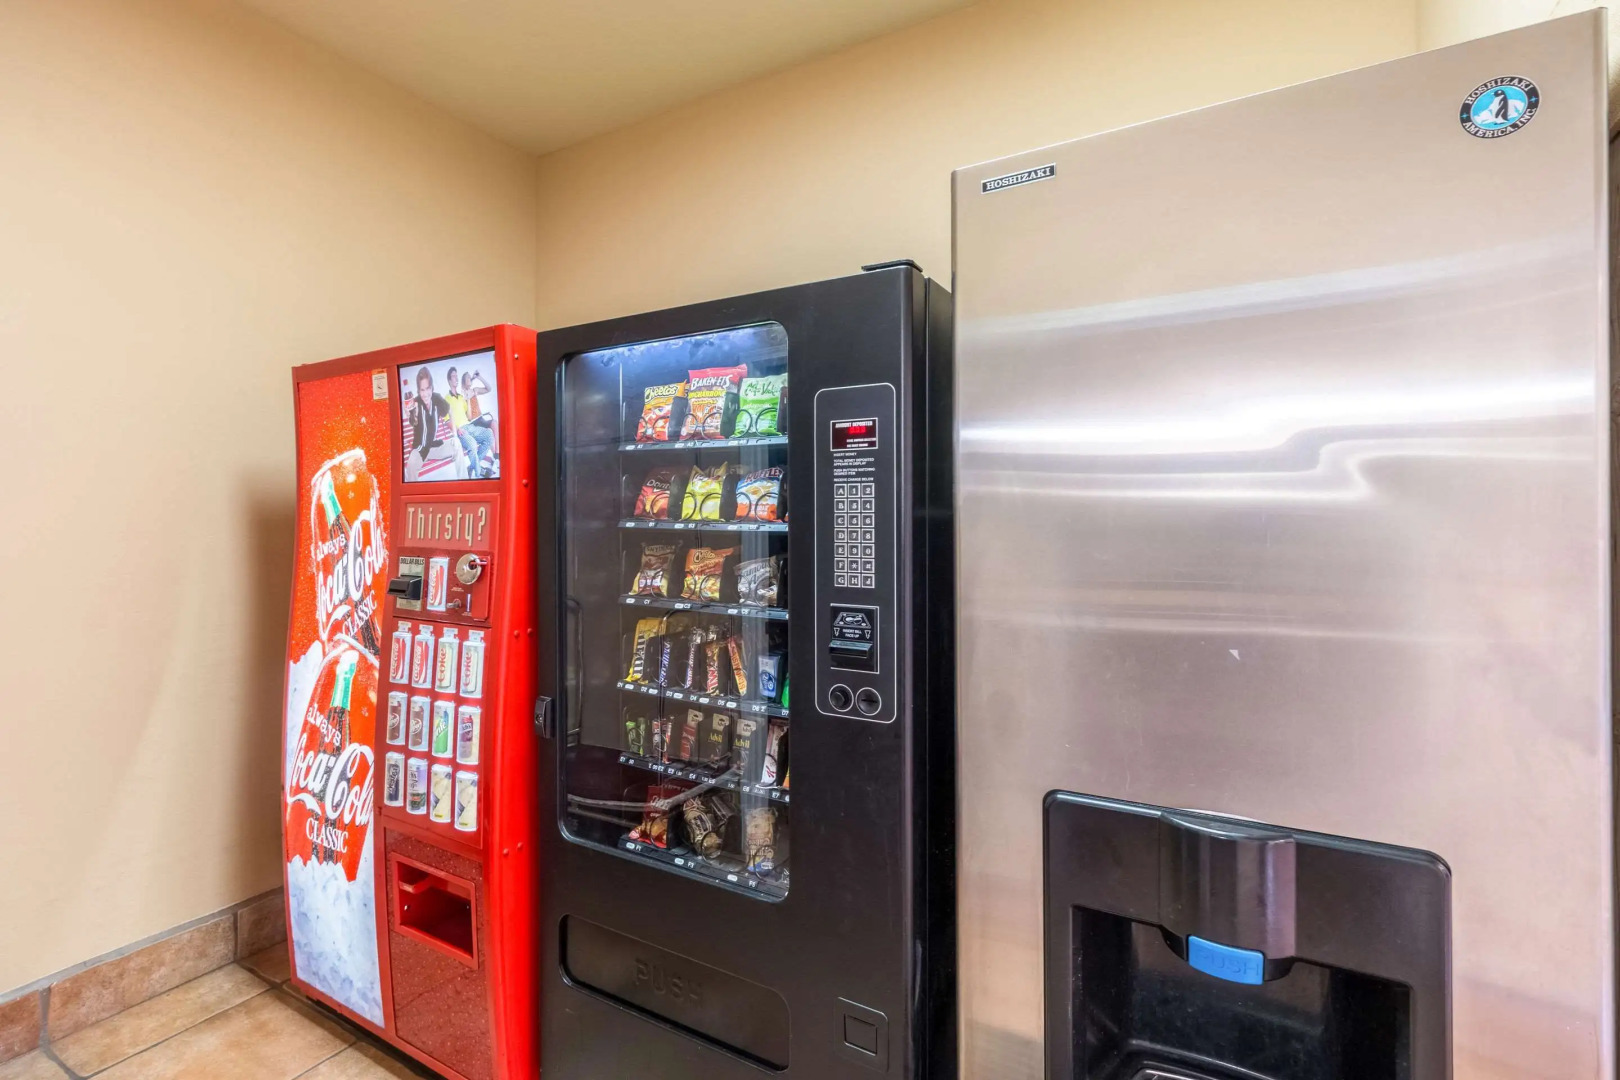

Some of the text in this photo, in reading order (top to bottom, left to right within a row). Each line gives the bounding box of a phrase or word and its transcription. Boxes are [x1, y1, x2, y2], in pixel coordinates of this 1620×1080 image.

[1464, 77, 1535, 105] HOSHIZAKI
[985, 166, 1051, 191] HOSHIZAKI
[644, 385, 679, 404] Cheetos
[646, 479, 670, 490] Dorit
[407, 505, 486, 547] Thirsty?
[311, 532, 347, 560] always
[341, 590, 378, 638] CLASSIC
[306, 703, 342, 746] always
[734, 737, 751, 749] Advil
[289, 733, 375, 827] Coca-Cola
[304, 816, 349, 854] CLASSIC
[1195, 948, 1260, 976] PUSH
